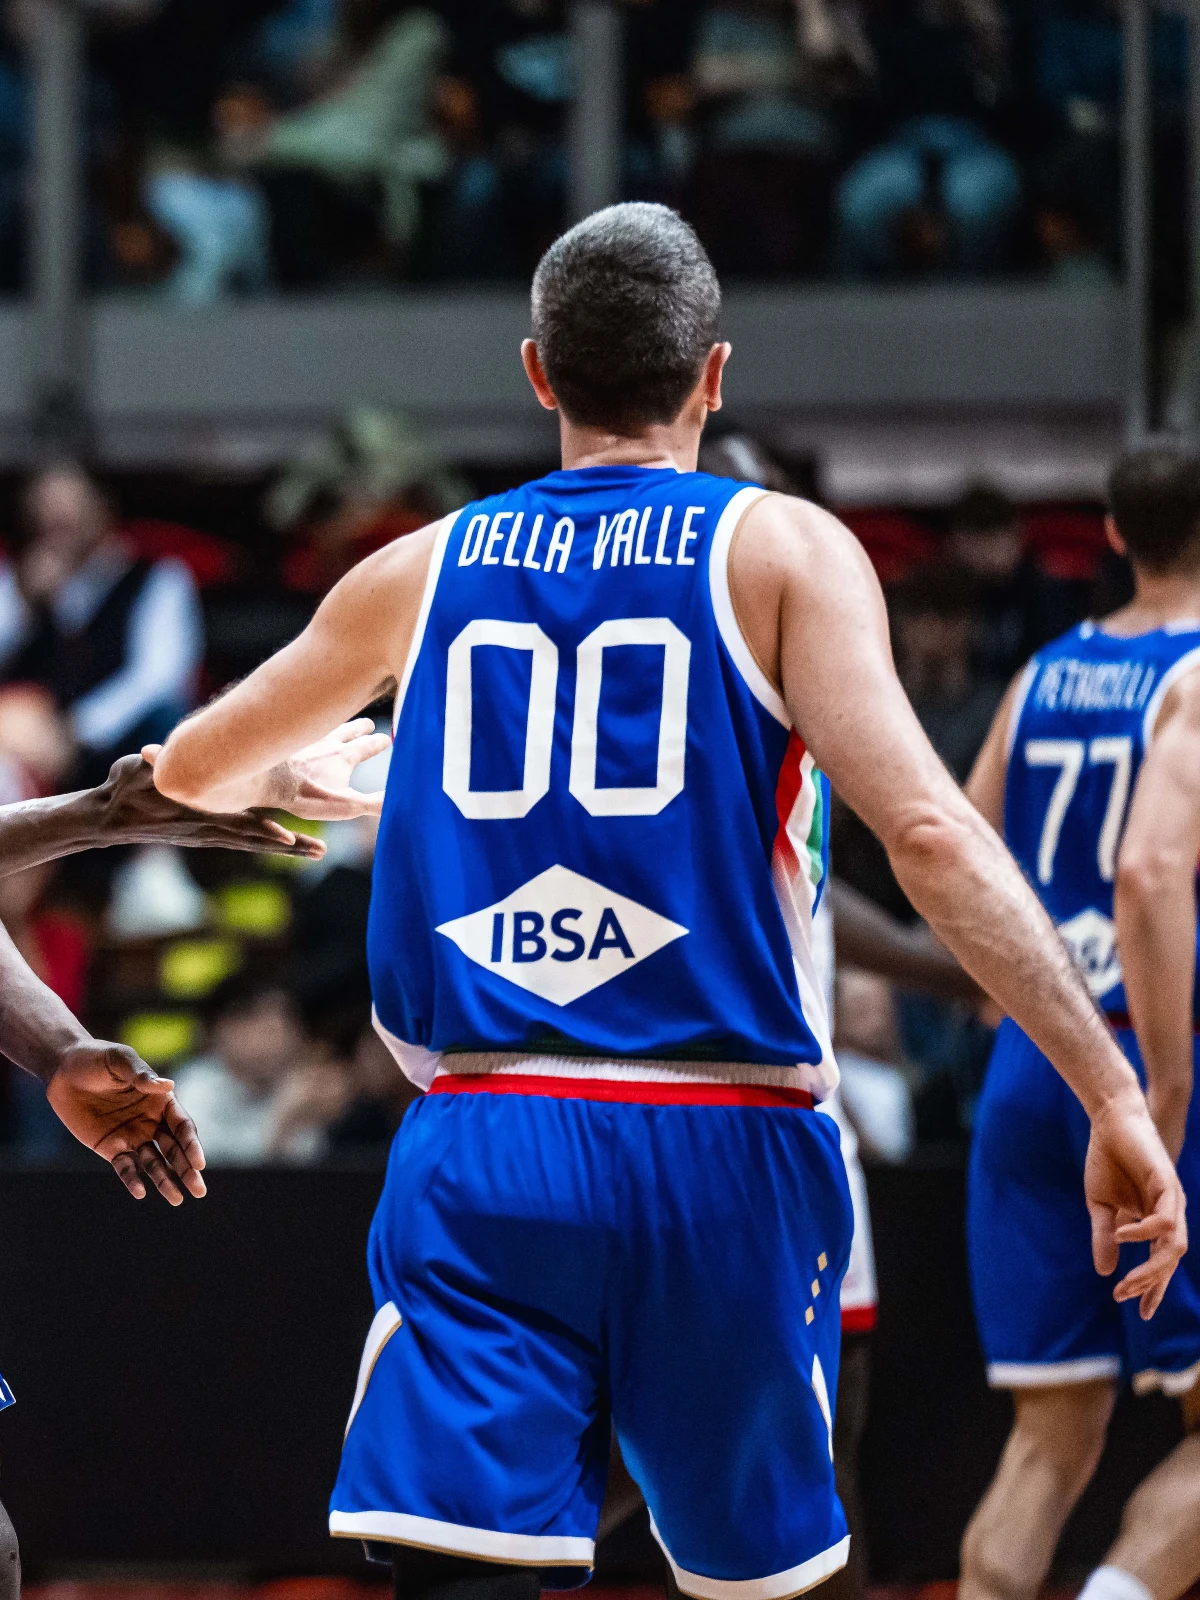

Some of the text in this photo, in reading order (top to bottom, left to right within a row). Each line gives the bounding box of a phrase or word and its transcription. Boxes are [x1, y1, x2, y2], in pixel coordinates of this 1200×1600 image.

[457, 505, 706, 574] DELLA VALLE
[442, 617, 692, 820] 00
[1025, 736, 1134, 884] 77
[490, 907, 636, 964] IBSA
